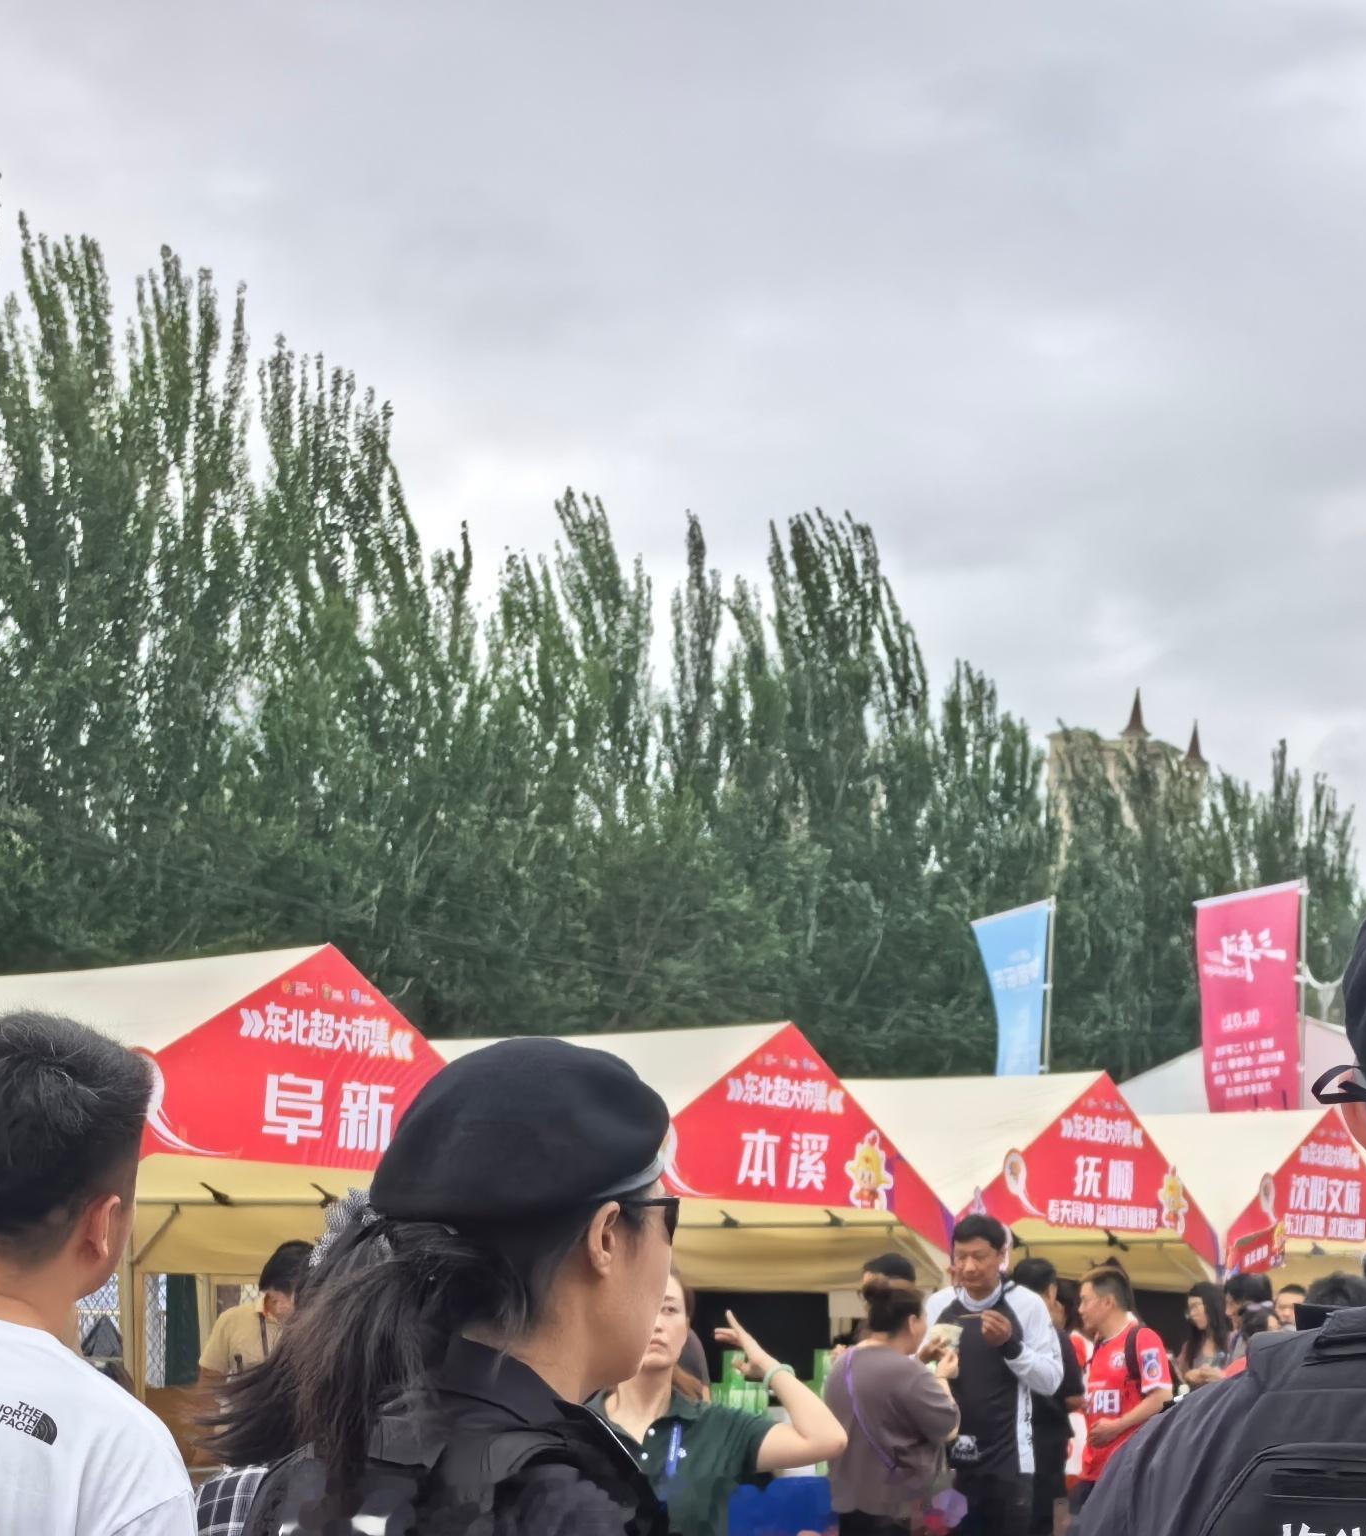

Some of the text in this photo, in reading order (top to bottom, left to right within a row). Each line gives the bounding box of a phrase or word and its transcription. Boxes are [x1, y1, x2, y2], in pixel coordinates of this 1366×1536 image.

[264, 1001, 391, 1057] 东北超大市集
[261, 1073, 396, 1152] 阜新
[742, 1071, 828, 1114] 东北超大市集
[737, 1128, 830, 1191] 本溪
[1073, 1155, 1134, 1200] 抚顺
[0, 1414, 34, 1435] FACE
[18, 1400, 42, 1417] THE
